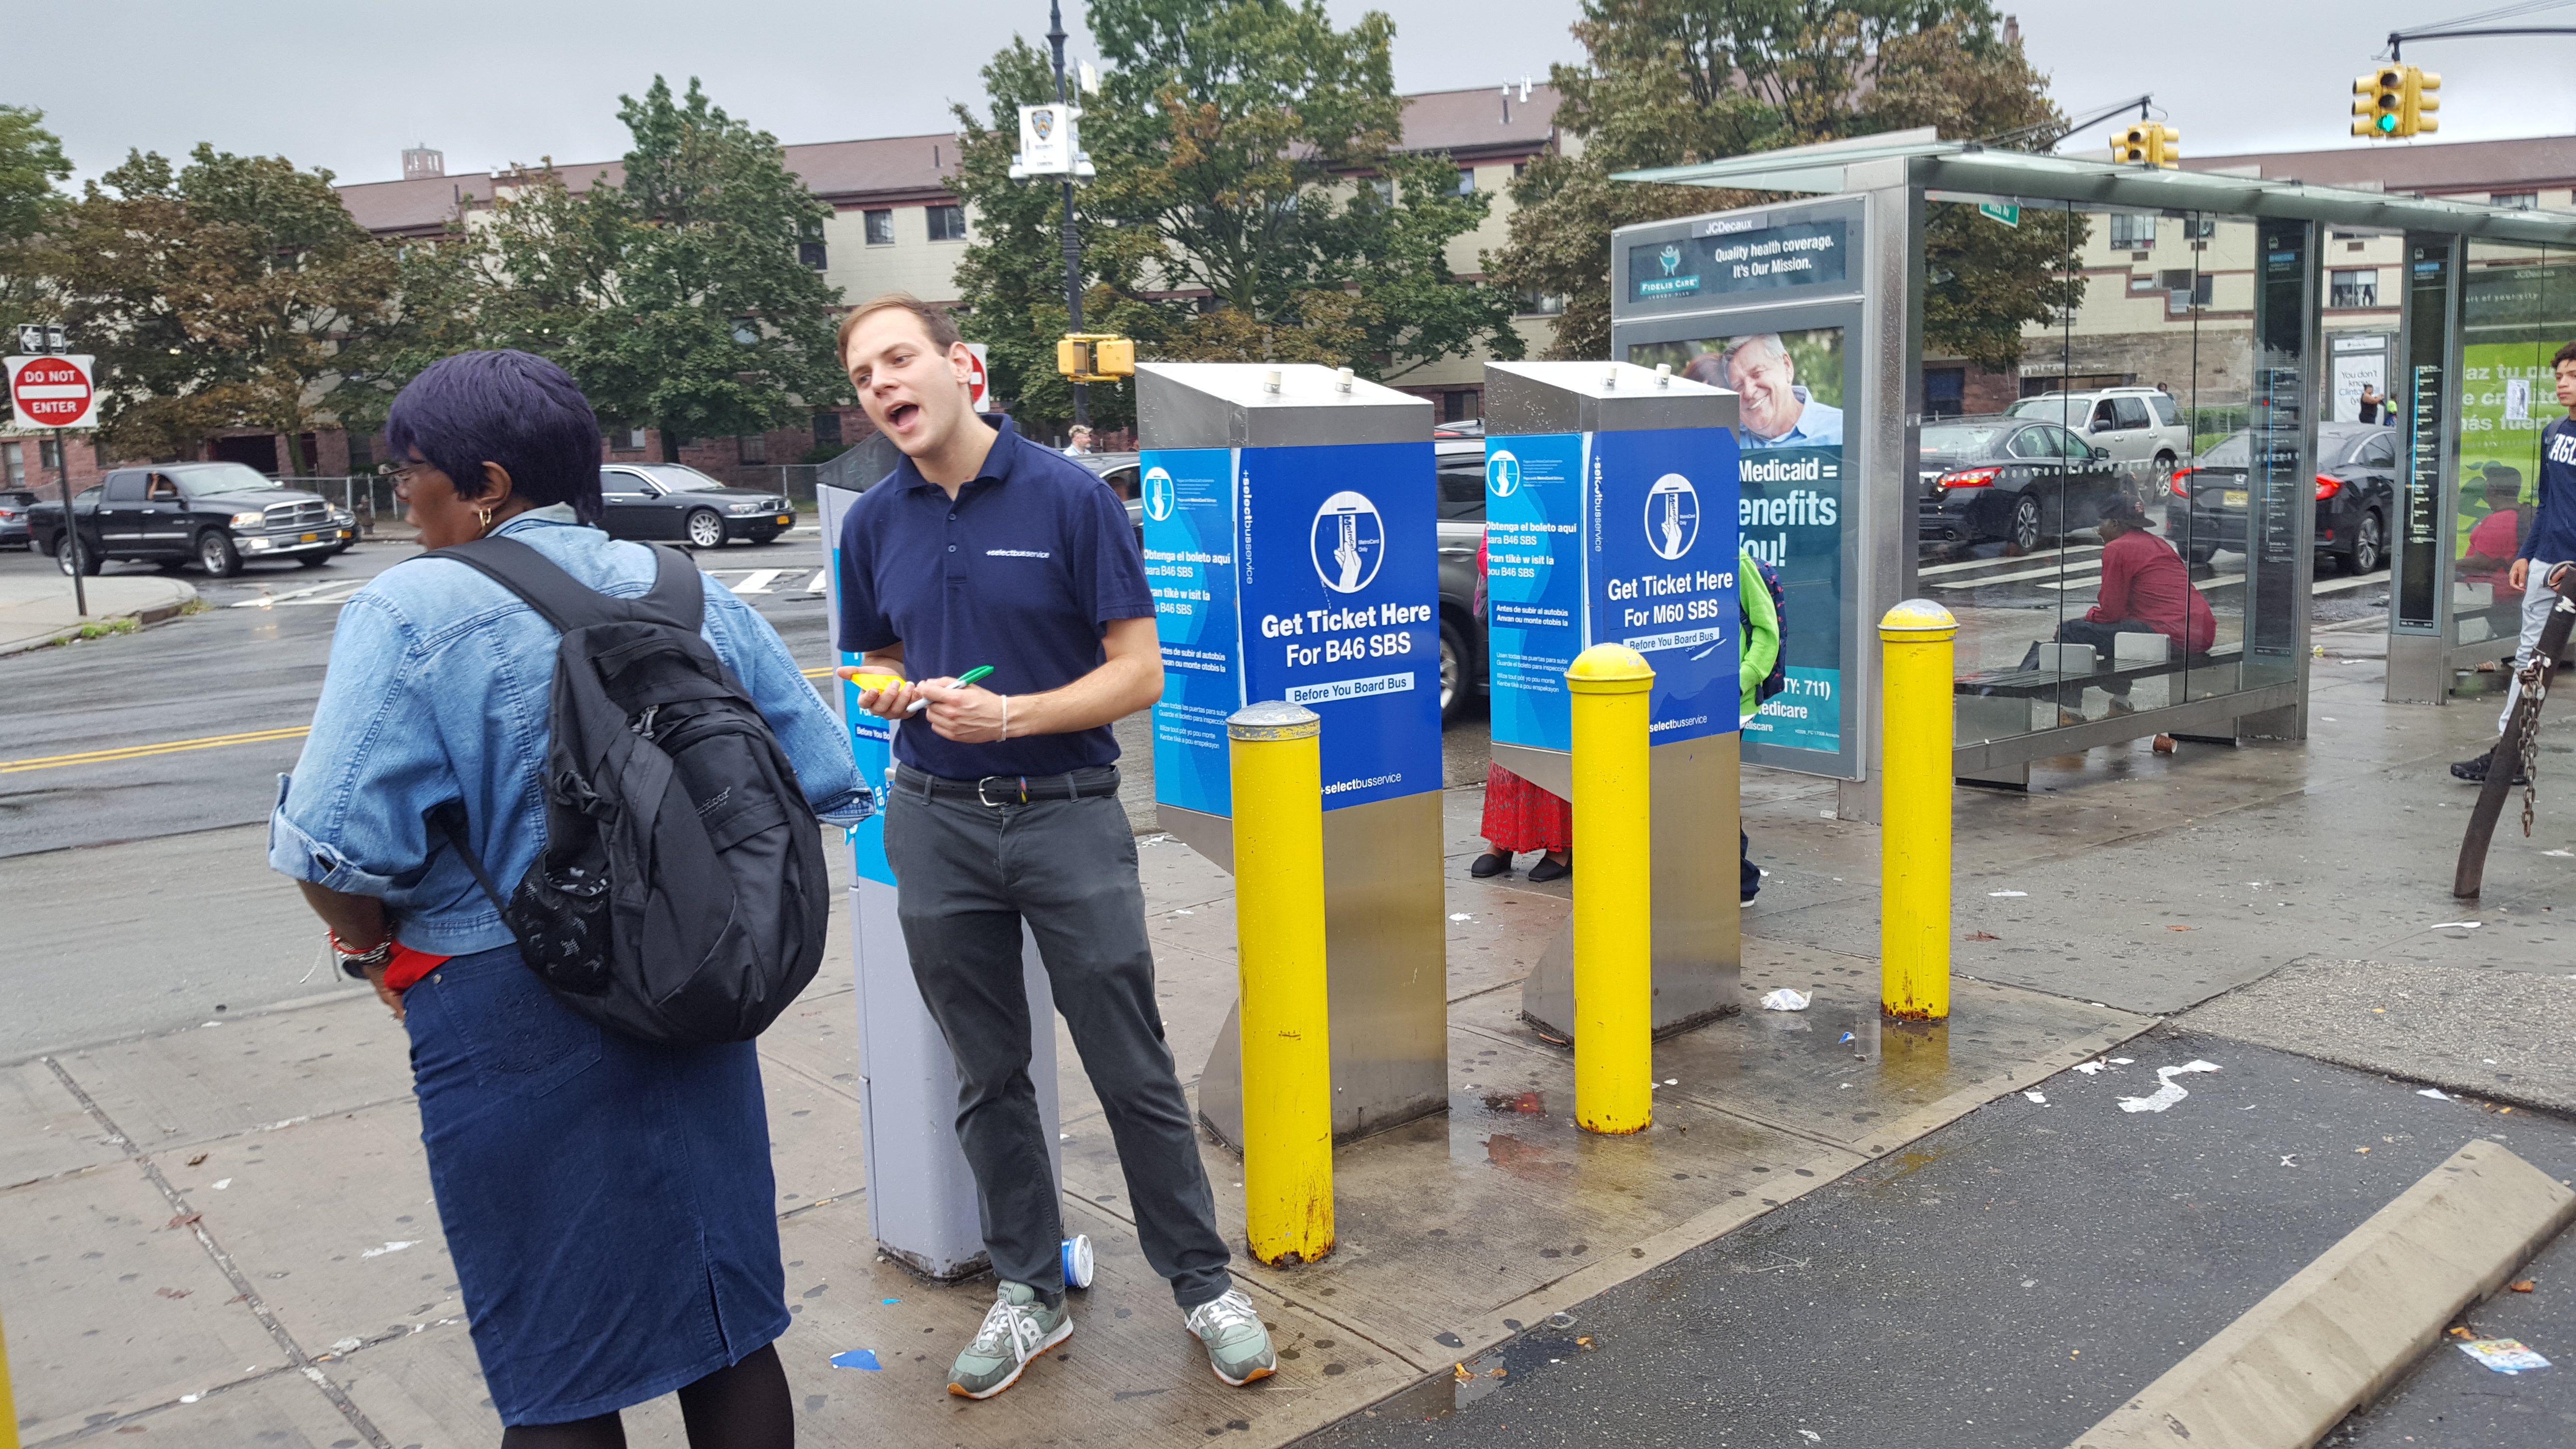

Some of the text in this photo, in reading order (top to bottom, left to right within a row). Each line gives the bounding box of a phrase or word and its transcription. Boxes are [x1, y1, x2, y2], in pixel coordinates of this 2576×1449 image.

[1706, 219, 1752, 235] JCDecaux
[1715, 235, 1834, 262] Quality health coverage.
[1733, 258, 1812, 279] It's Our Mission.
[1642, 282, 1673, 292] FIDELIS
[24, 370, 76, 383] DO NOT
[2341, 369, 2378, 379] You don't
[2496, 364, 2520, 379] tu
[32, 401, 77, 414] ENTER
[1739, 457, 1819, 482] Medicaid
[1739, 489, 1837, 526] enefits
[1486, 521, 1577, 534] Obtenga el boleto aquí
[1503, 535, 1519, 545] B46
[1520, 535, 1537, 545] SBS
[1739, 532, 1787, 567] ou!
[1144, 549, 1231, 565] Obtenga el boleto aquí
[1487, 553, 1504, 563] Pran
[1505, 554, 1522, 564] tikè
[1546, 556, 1555, 565] la
[1160, 565, 1176, 577] B46
[1177, 566, 1193, 578] SBS
[1501, 567, 1516, 577] B46
[1517, 568, 1535, 578] SBS
[1608, 570, 1733, 601] Get Ticket Here
[1150, 588, 1162, 597] ran
[1164, 587, 1179, 598] tikè
[1203, 590, 1210, 601] la
[1159, 602, 1175, 613] B46
[1176, 603, 1192, 615] SBS
[1625, 599, 1718, 628] For M60 SBS
[1262, 603, 1431, 638] Get Ticket Here
[1630, 632, 1714, 650] Before You Board Bus
[1173, 647, 1181, 656] de
[1181, 649, 1195, 658] subir
[1202, 652, 1226, 661] autobús
[1287, 632, 1411, 667] For B46 SBS
[1183, 661, 1201, 670] monte
[1202, 663, 1220, 673] otobis
[1220, 665, 1226, 673] la
[1294, 677, 1406, 702] Before You Board Bus
[1784, 677, 1831, 701] TY: 711)
[1170, 702, 1182, 710] todas
[1189, 705, 1205, 713] puertas
[1758, 701, 1808, 719] edicare
[856, 726, 883, 739] Before You
[1745, 721, 1773, 732] eliscare
